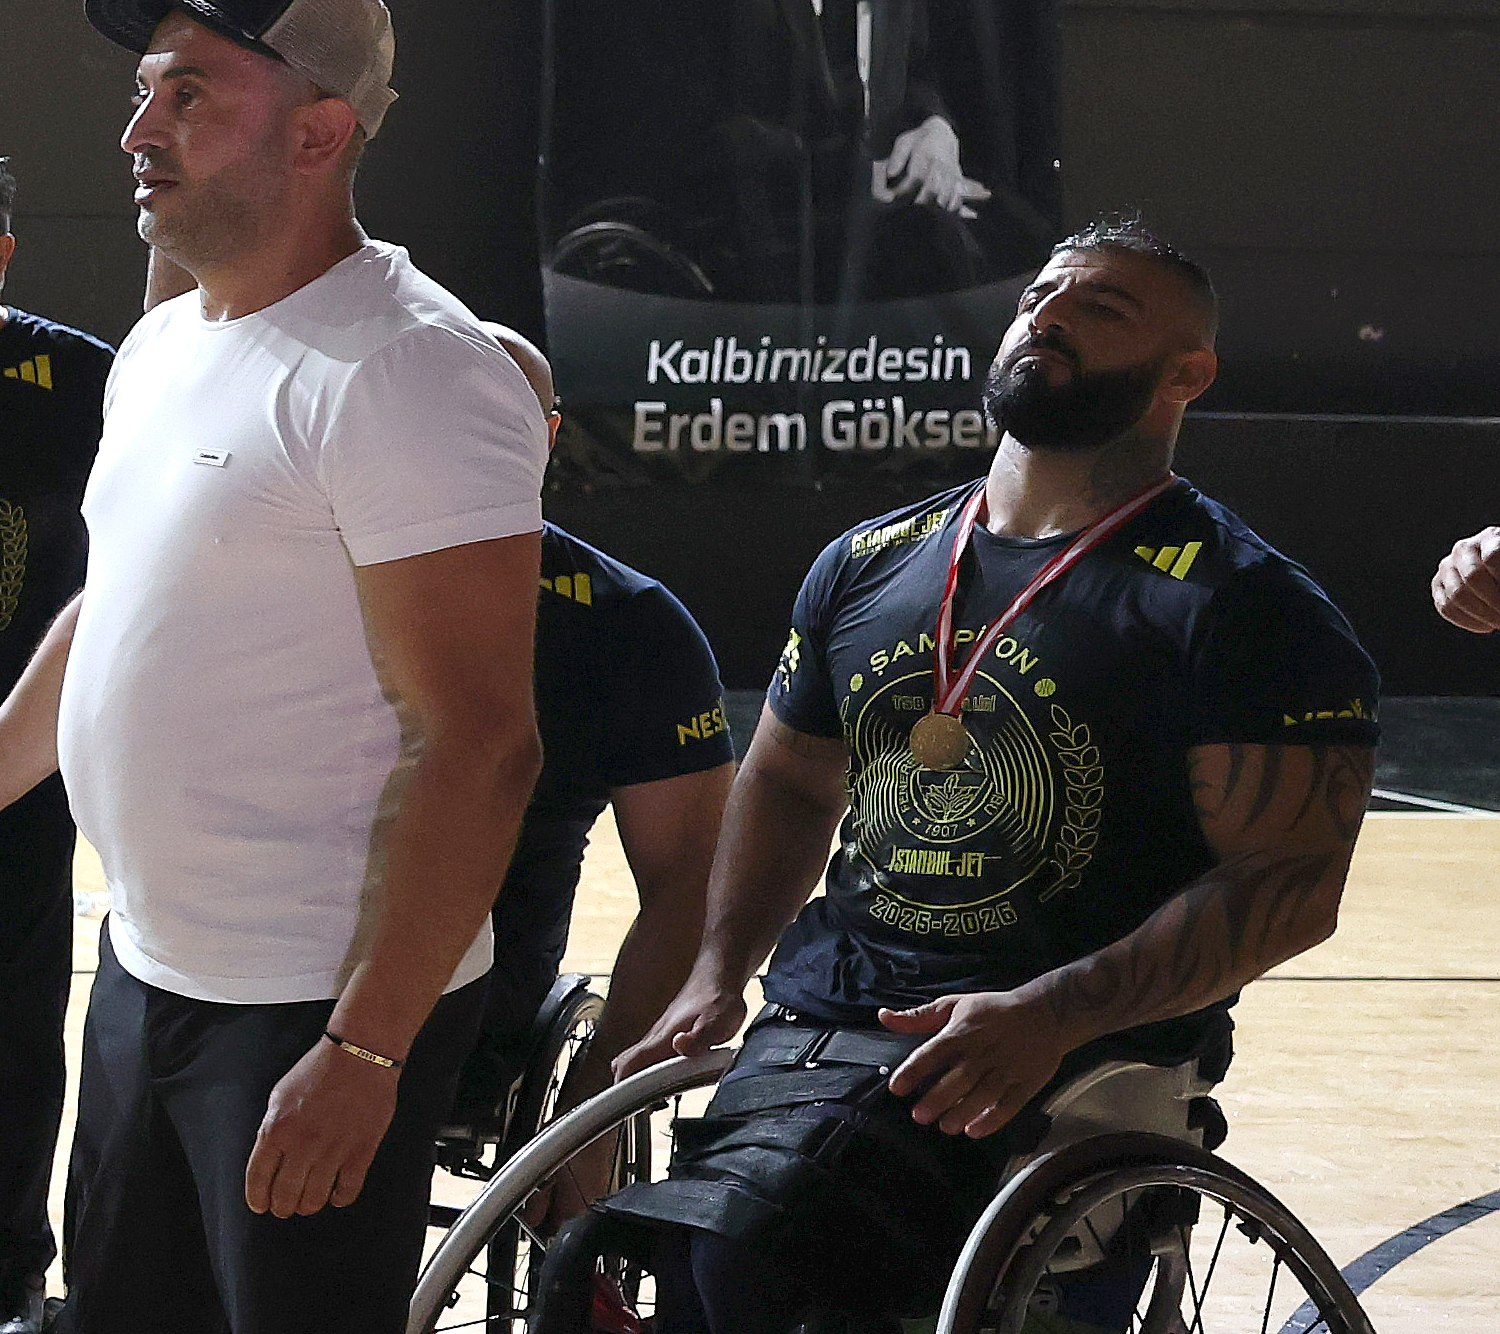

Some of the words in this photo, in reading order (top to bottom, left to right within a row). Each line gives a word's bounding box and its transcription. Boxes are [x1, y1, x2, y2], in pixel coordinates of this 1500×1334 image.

[646, 334, 971, 385] Kalbimizdesin
[632, 397, 807, 453] Erdem
[869, 624, 1040, 677] ŞAMPİON
[925, 824, 960, 837] 1907
[888, 844, 954, 876] İSTANBUL
[956, 851, 986, 878] JET
[868, 893, 1018, 937] 2025-2026
